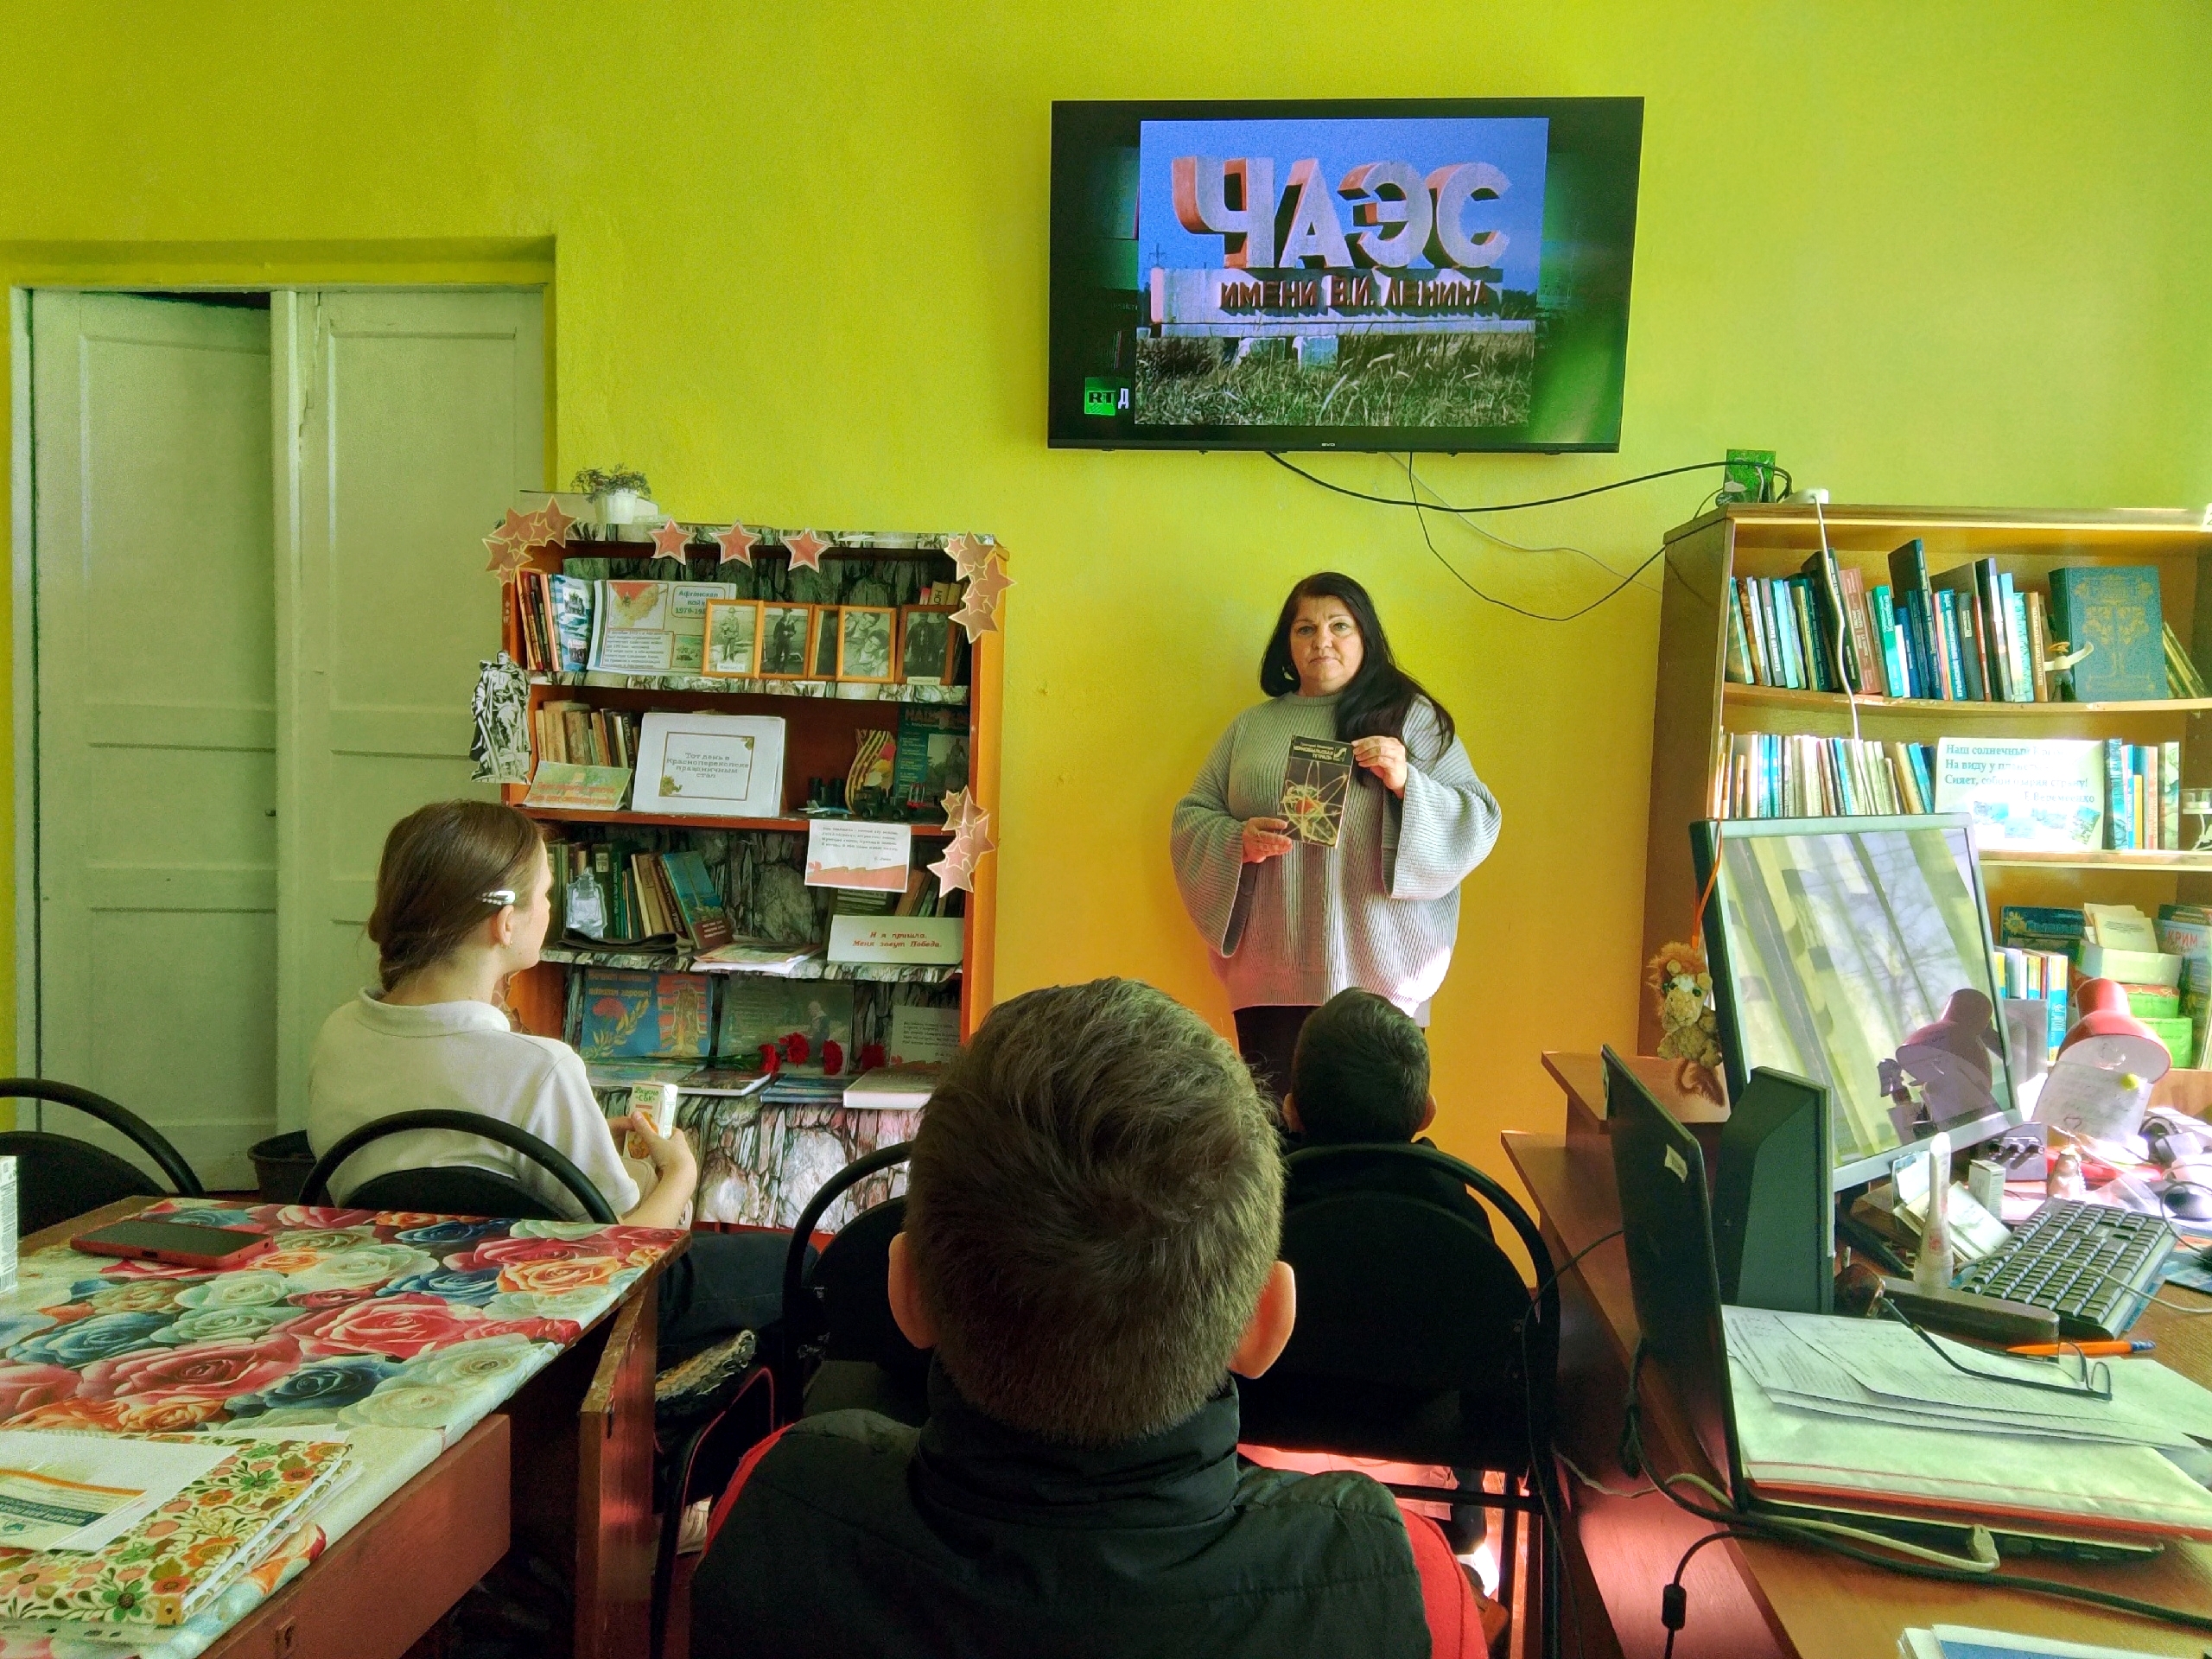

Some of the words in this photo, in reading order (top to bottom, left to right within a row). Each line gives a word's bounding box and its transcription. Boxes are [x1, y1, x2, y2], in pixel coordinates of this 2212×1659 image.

[1172, 156, 1512, 269] ЧАЭС
[1219, 279, 1317, 308] ИМЕНИ
[1326, 274, 1376, 308] В.И.
[1381, 276, 1490, 308] ЛЕНИНА
[1088, 391, 1116, 404] RT
[1946, 744, 1970, 755] Наш
[1972, 745, 2031, 755] солнечный
[666, 758, 749, 768] Красноперекопске
[1945, 759, 1959, 769] На
[1961, 761, 1986, 772] виду
[1988, 762, 1996, 773] у
[1944, 775, 1979, 785] Сияет,
